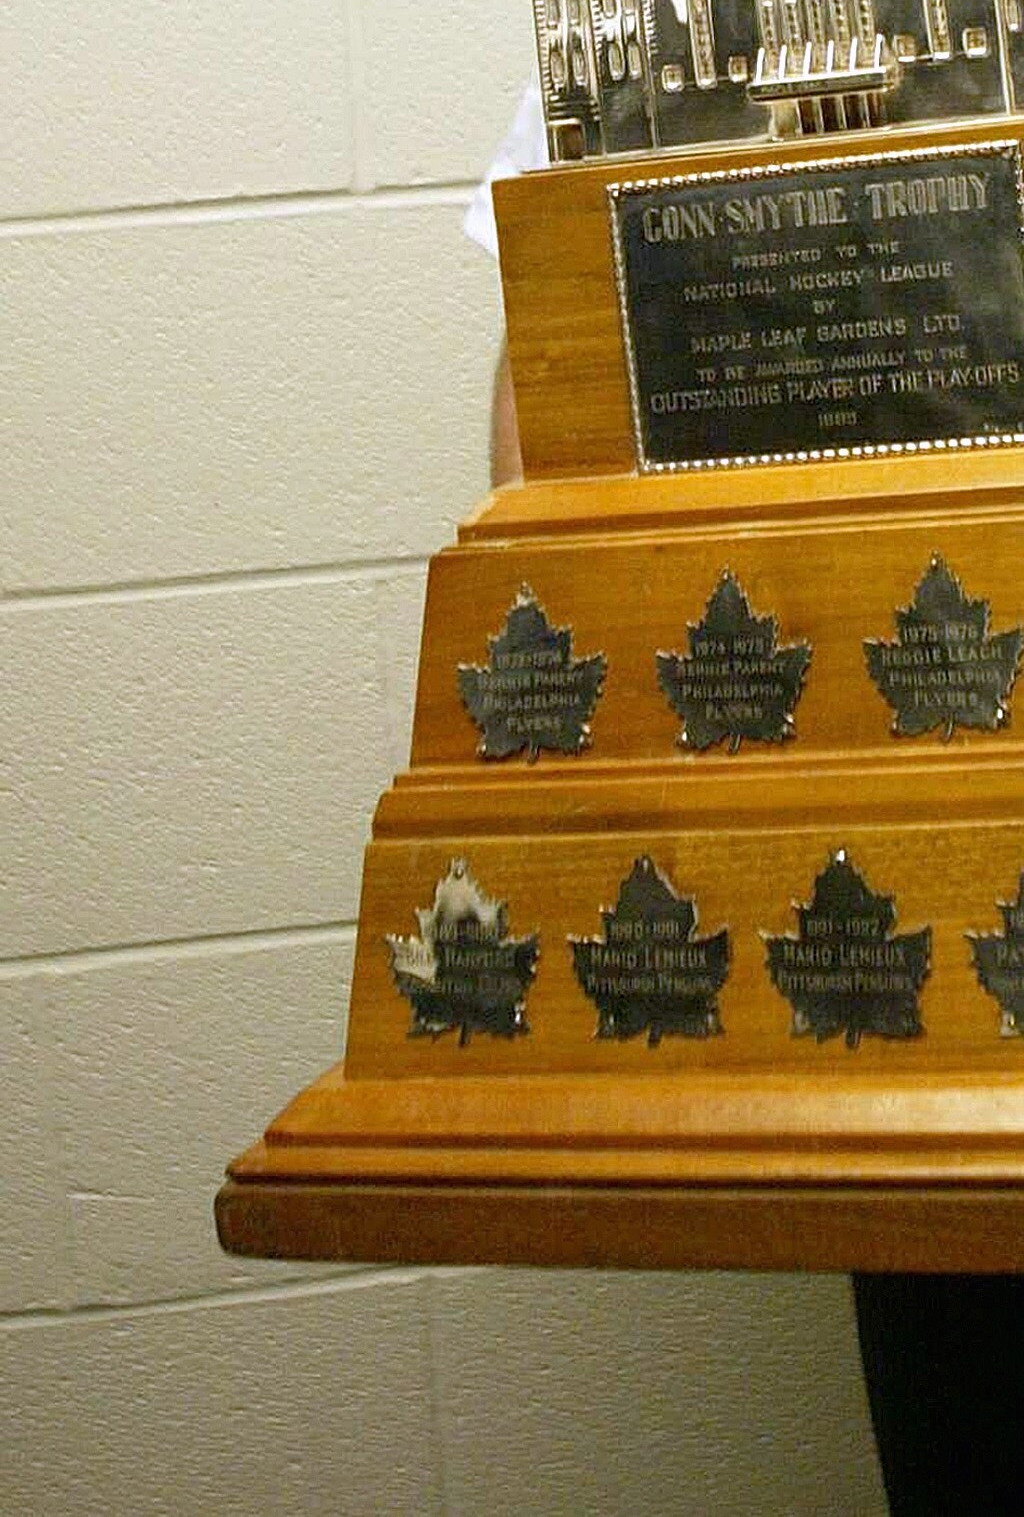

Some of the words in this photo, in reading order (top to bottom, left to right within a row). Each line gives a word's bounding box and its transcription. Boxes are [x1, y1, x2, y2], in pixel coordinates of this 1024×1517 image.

[643, 200, 716, 244] CONN
[723, 186, 849, 234] SMYTHE
[865, 172, 991, 220] TROPHY
[732, 247, 822, 270] PRESENTED
[836, 244, 857, 259] TO
[868, 240, 901, 256] THE
[684, 277, 776, 302] NATIONAL
[789, 270, 865, 292] HOCKEY
[880, 261, 955, 283] LEAGUE
[812, 298, 837, 315] BY
[691, 332, 752, 355] MAPLE
[761, 325, 808, 348] LEAF
[816, 316, 907, 342] GARDENS
[697, 368, 716, 383] TO
[725, 364, 748, 381] BE
[754, 357, 825, 377] AWARDED
[831, 350, 906, 372] ANNUALLY
[915, 348, 934, 363] TO
[940, 345, 968, 361] THE
[651, 384, 782, 414] OUTSTANDING
[787, 377, 855, 404] PLAYER
[859, 373, 883, 396] OF
[886, 369, 923, 394] THE
[947, 642, 1005, 664] LEACH
